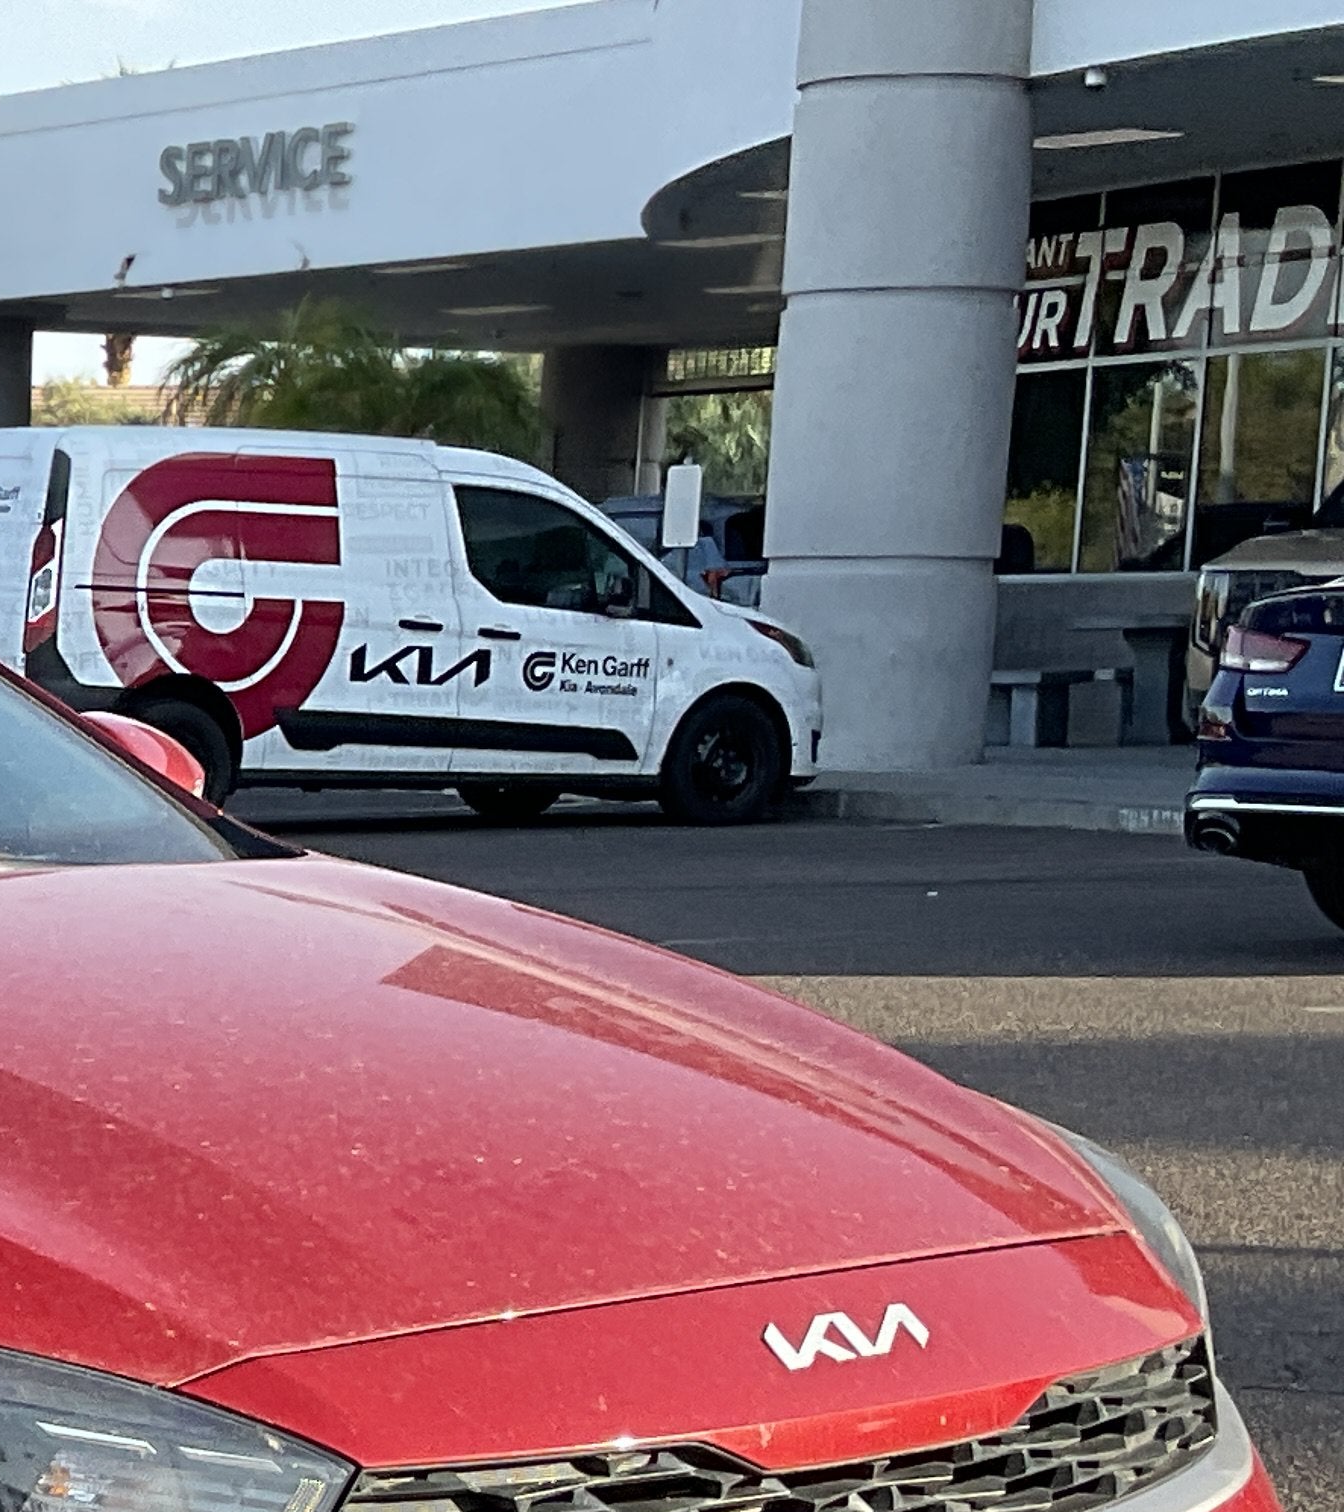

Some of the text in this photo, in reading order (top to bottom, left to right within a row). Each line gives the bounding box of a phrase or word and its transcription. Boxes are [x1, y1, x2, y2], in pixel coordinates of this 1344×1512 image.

[158, 121, 355, 206] SERVICE
[1025, 231, 1075, 270] ANT
[1072, 203, 1344, 349] TRAD
[349, 643, 492, 688] KIA
[560, 652, 650, 679] Ken Garff
[761, 1302, 930, 1371] KIA
